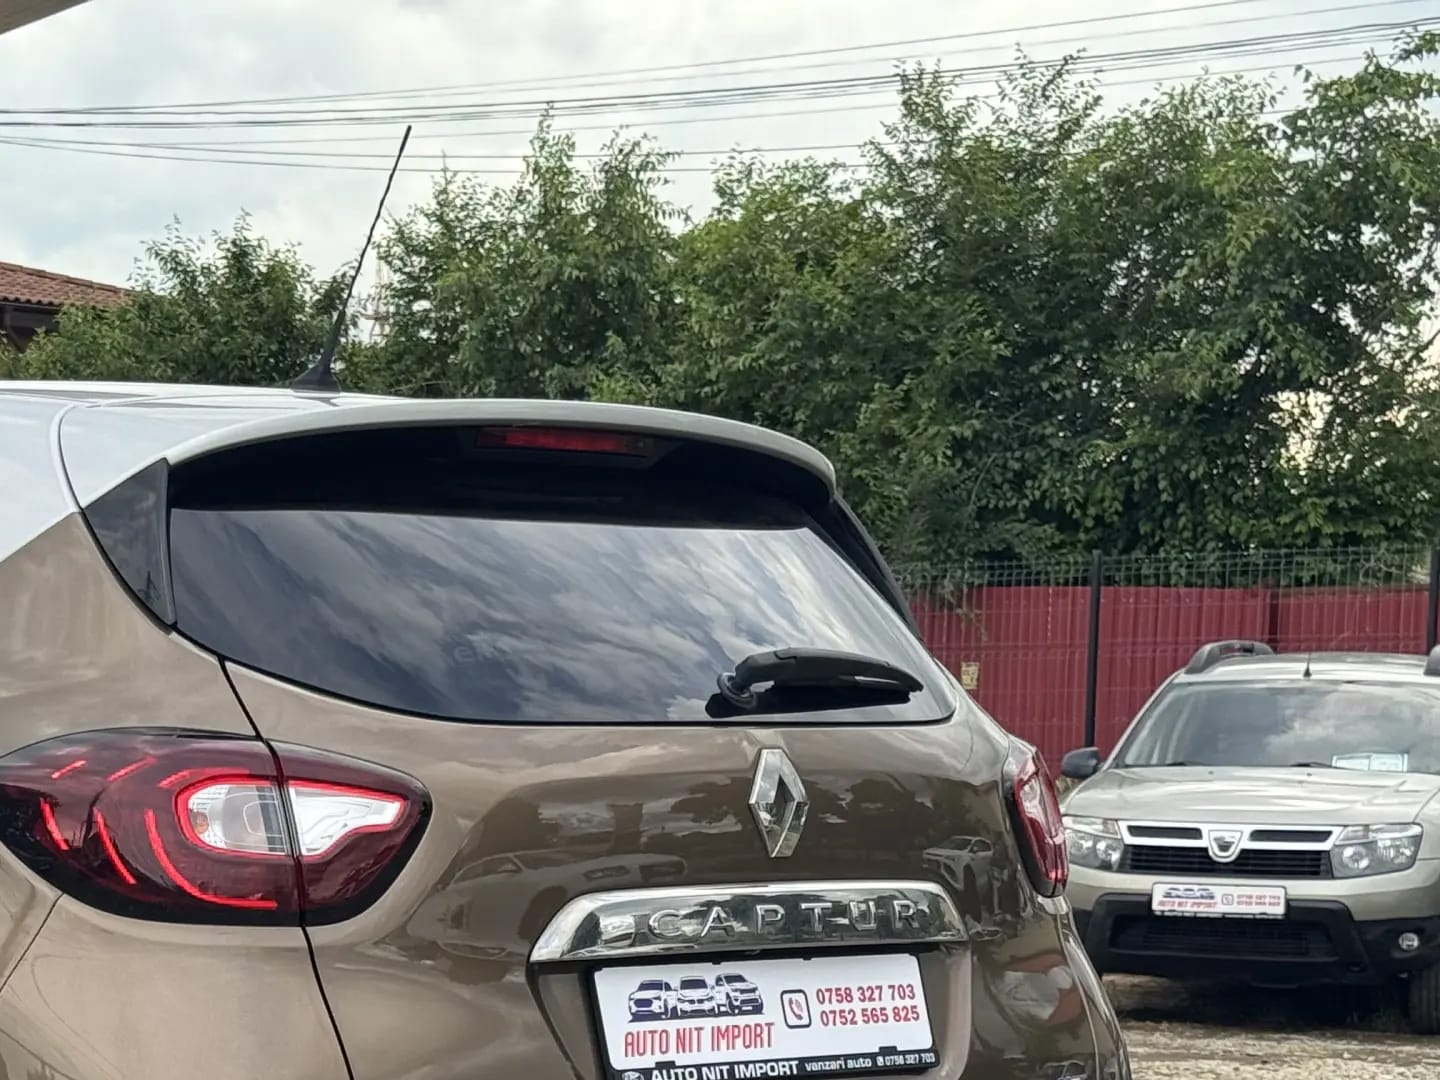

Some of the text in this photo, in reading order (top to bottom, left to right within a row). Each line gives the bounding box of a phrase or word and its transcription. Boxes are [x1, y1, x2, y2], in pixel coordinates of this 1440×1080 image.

[647, 899, 920, 938] CAPTUR
[816, 983, 915, 1005] 0758 327 703
[820, 1005, 920, 1027] 0752 565 825
[624, 1022, 774, 1057] AUTO NIT IMPORT
[702, 1065, 730, 1080] NIT
[735, 1060, 799, 1079] IMPORT
[847, 1057, 872, 1069] auto
